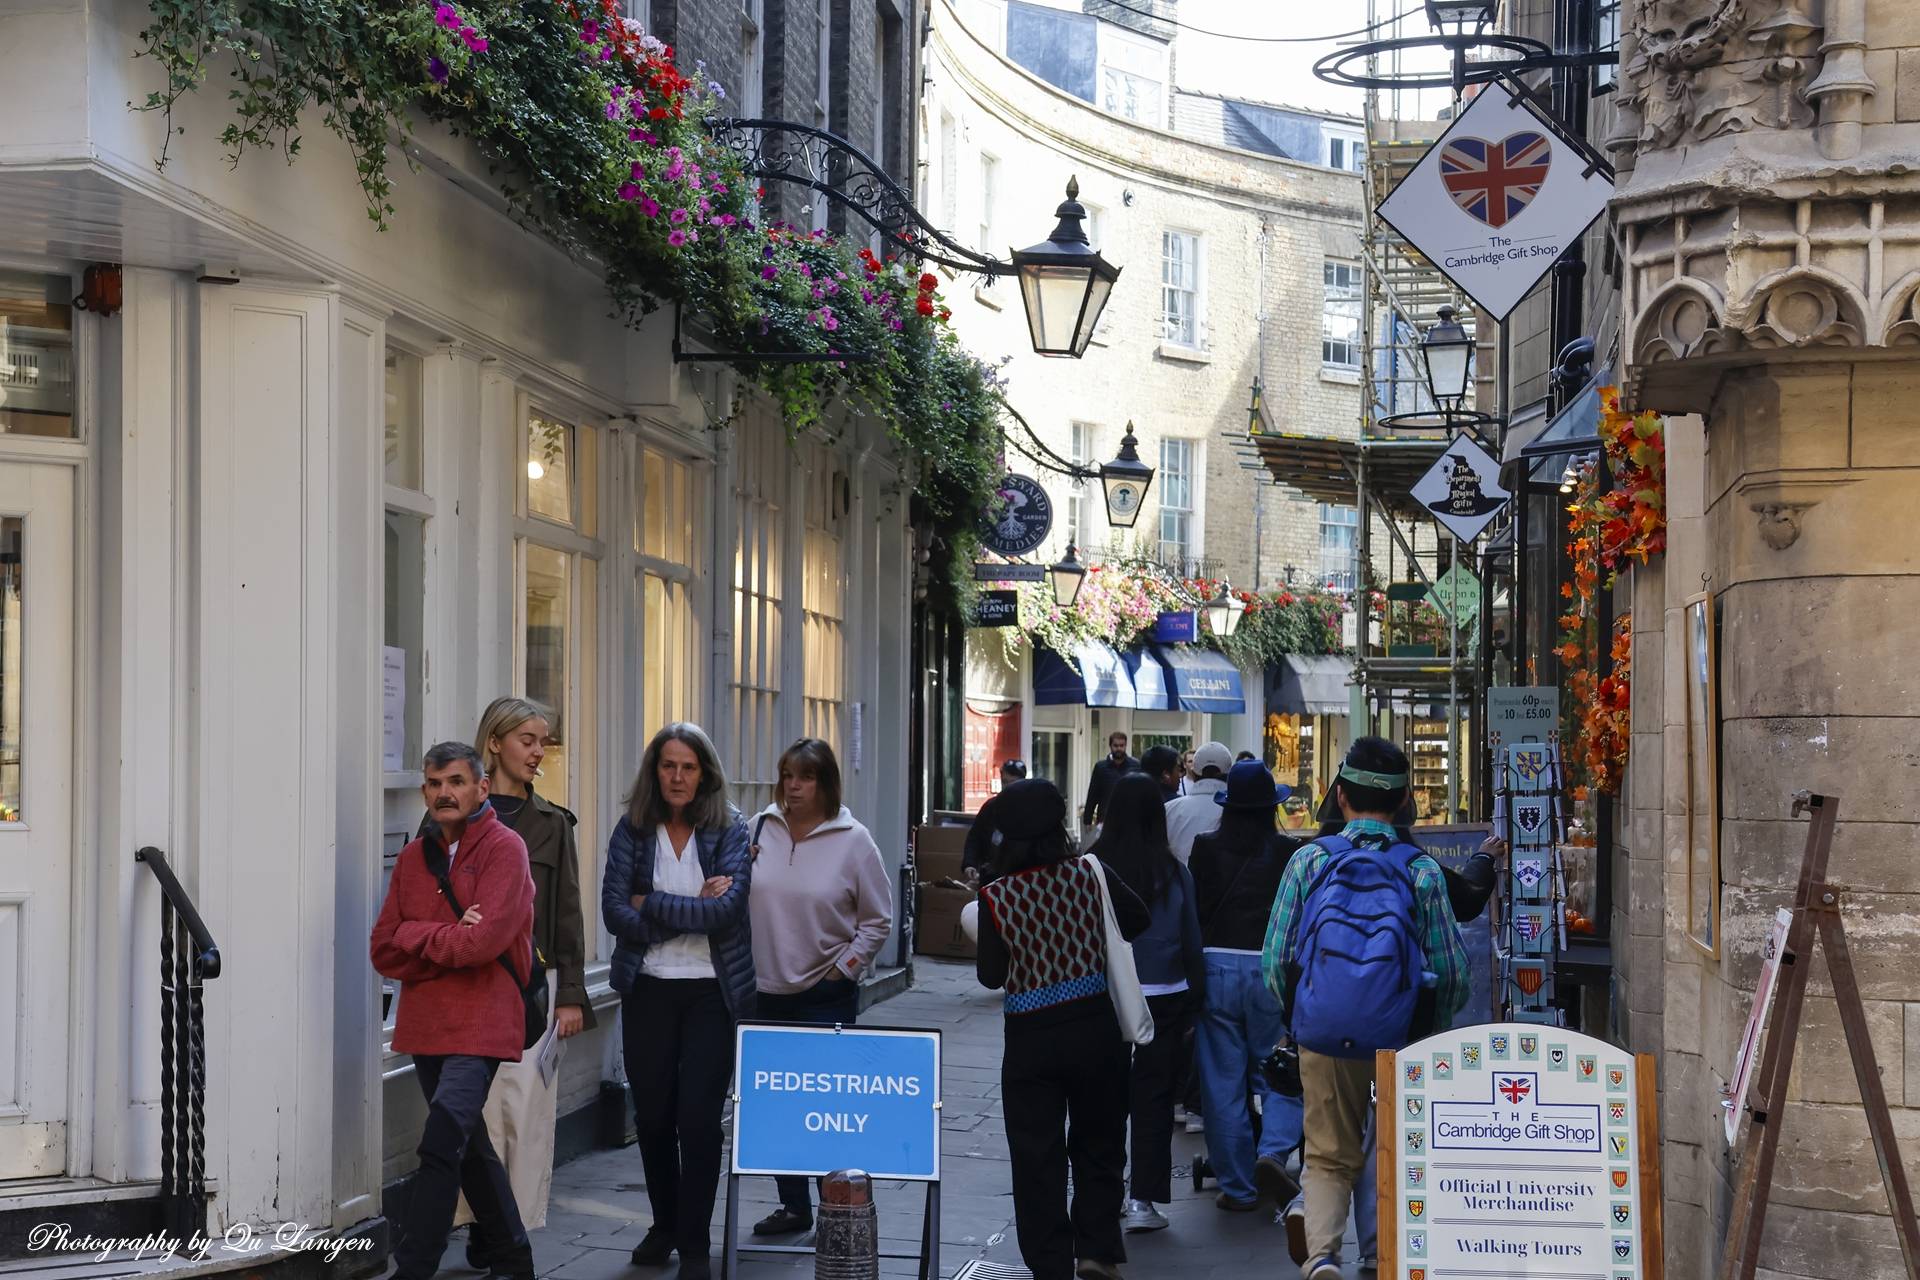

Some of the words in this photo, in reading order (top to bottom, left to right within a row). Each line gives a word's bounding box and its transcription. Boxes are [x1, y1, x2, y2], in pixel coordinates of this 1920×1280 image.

[1489, 236, 1512, 248] The
[1445, 251, 1506, 268] Cambridge
[1507, 247, 1529, 260] Gift
[1530, 244, 1559, 257] Shop
[1456, 464, 1469, 474] The
[1447, 474, 1481, 485] Department
[1459, 481, 1467, 490] of
[1018, 480, 1047, 512] YARD
[1451, 489, 1476, 499] Magical
[1453, 500, 1473, 509] Gifts
[976, 603, 1016, 613] HEANEY
[1522, 694, 1540, 708] 60p
[1505, 709, 1515, 720] 10
[1526, 708, 1551, 719] £5.00
[754, 1071, 921, 1096] PEDESTRIANS
[805, 1112, 869, 1133] ONLY
[1492, 1111, 1539, 1122] THE
[1438, 1122, 1521, 1142] Cambridge
[1524, 1123, 1551, 1139] Gift
[1554, 1124, 1595, 1143] Shop
[1439, 1179, 1501, 1194] Official
[1506, 1180, 1596, 1200] University
[1463, 1195, 1574, 1212] Merchandise
[1456, 1238, 1528, 1258] Walking
[1531, 1240, 1583, 1256] Tours
